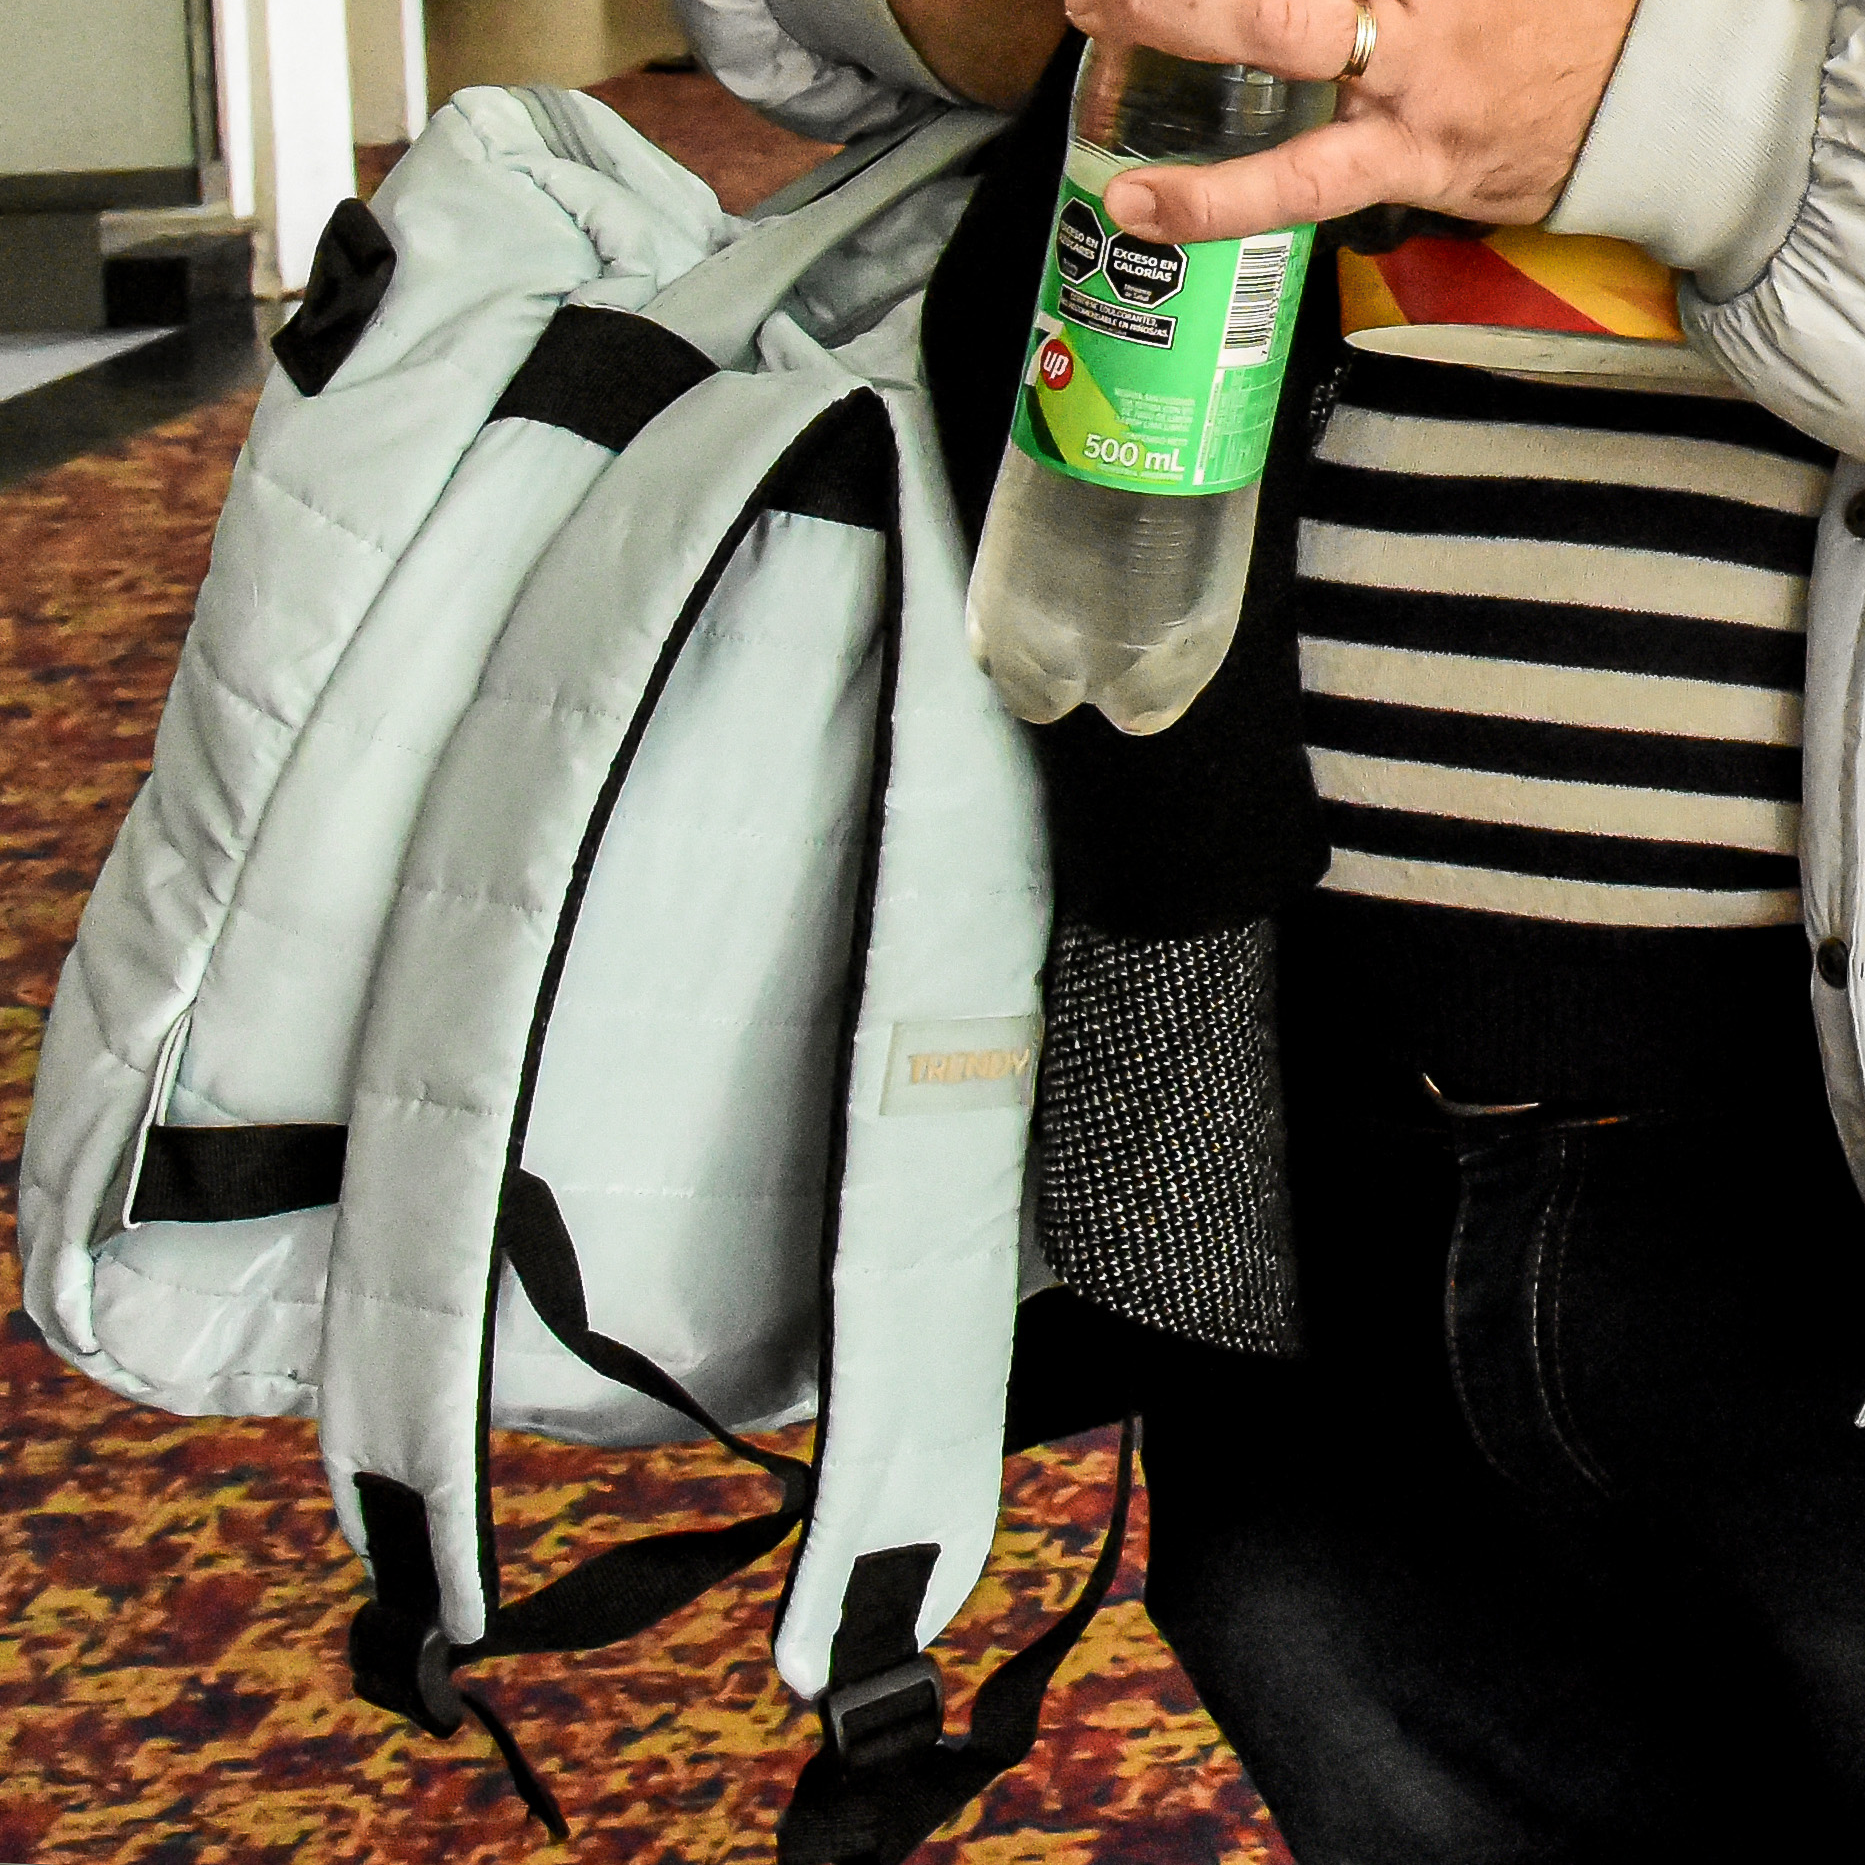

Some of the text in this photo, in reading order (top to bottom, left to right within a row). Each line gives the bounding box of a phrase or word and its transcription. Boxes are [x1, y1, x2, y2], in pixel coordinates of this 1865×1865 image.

[1113, 247, 1178, 272] EXCESO EN
[1113, 260, 1172, 283] CALORÍAS
[1083, 433, 1139, 467] 500
[1144, 448, 1185, 472] mL
[909, 1047, 1030, 1085] TRENDY
